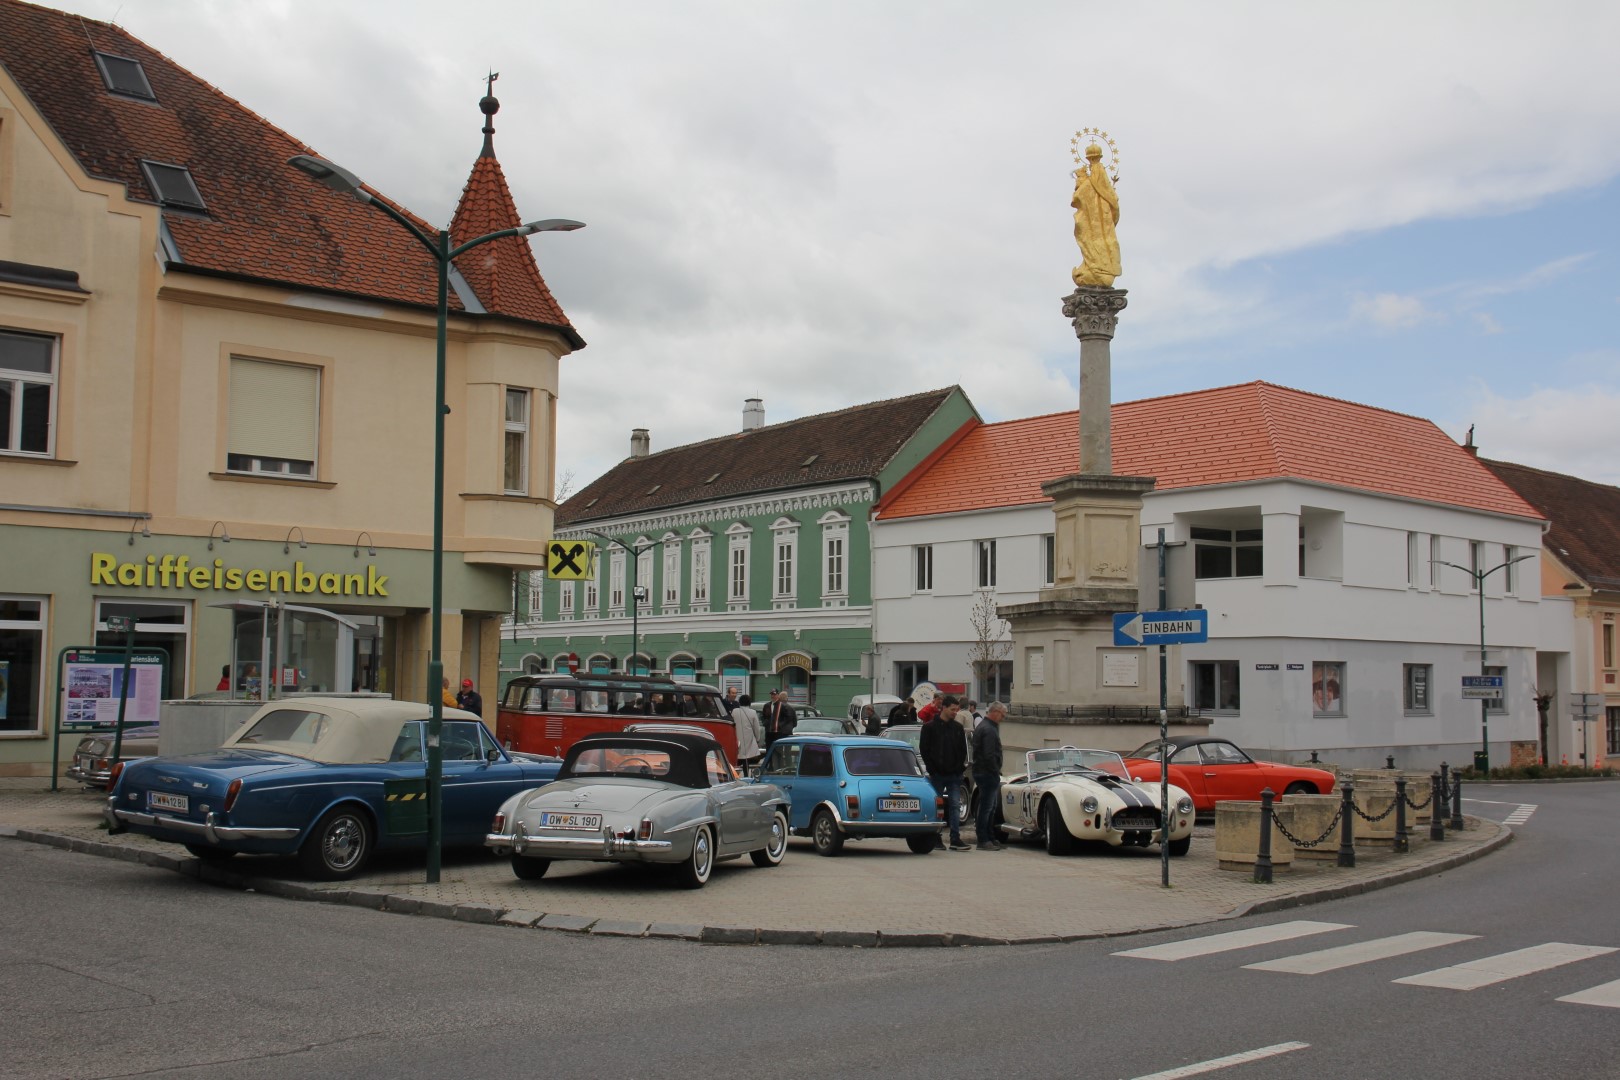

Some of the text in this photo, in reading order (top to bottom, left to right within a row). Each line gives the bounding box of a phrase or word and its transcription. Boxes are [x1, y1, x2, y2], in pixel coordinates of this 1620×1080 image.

[91, 553, 389, 597] Raiffeisenbank
[1143, 621, 1193, 634] EINBAHN
[130, 655, 160, 664] ariensäule
[778, 655, 810, 668] FRIEDRICH
[1022, 791, 1032, 818] 41
[568, 815, 579, 826] SL
[582, 816, 598, 827] 190
